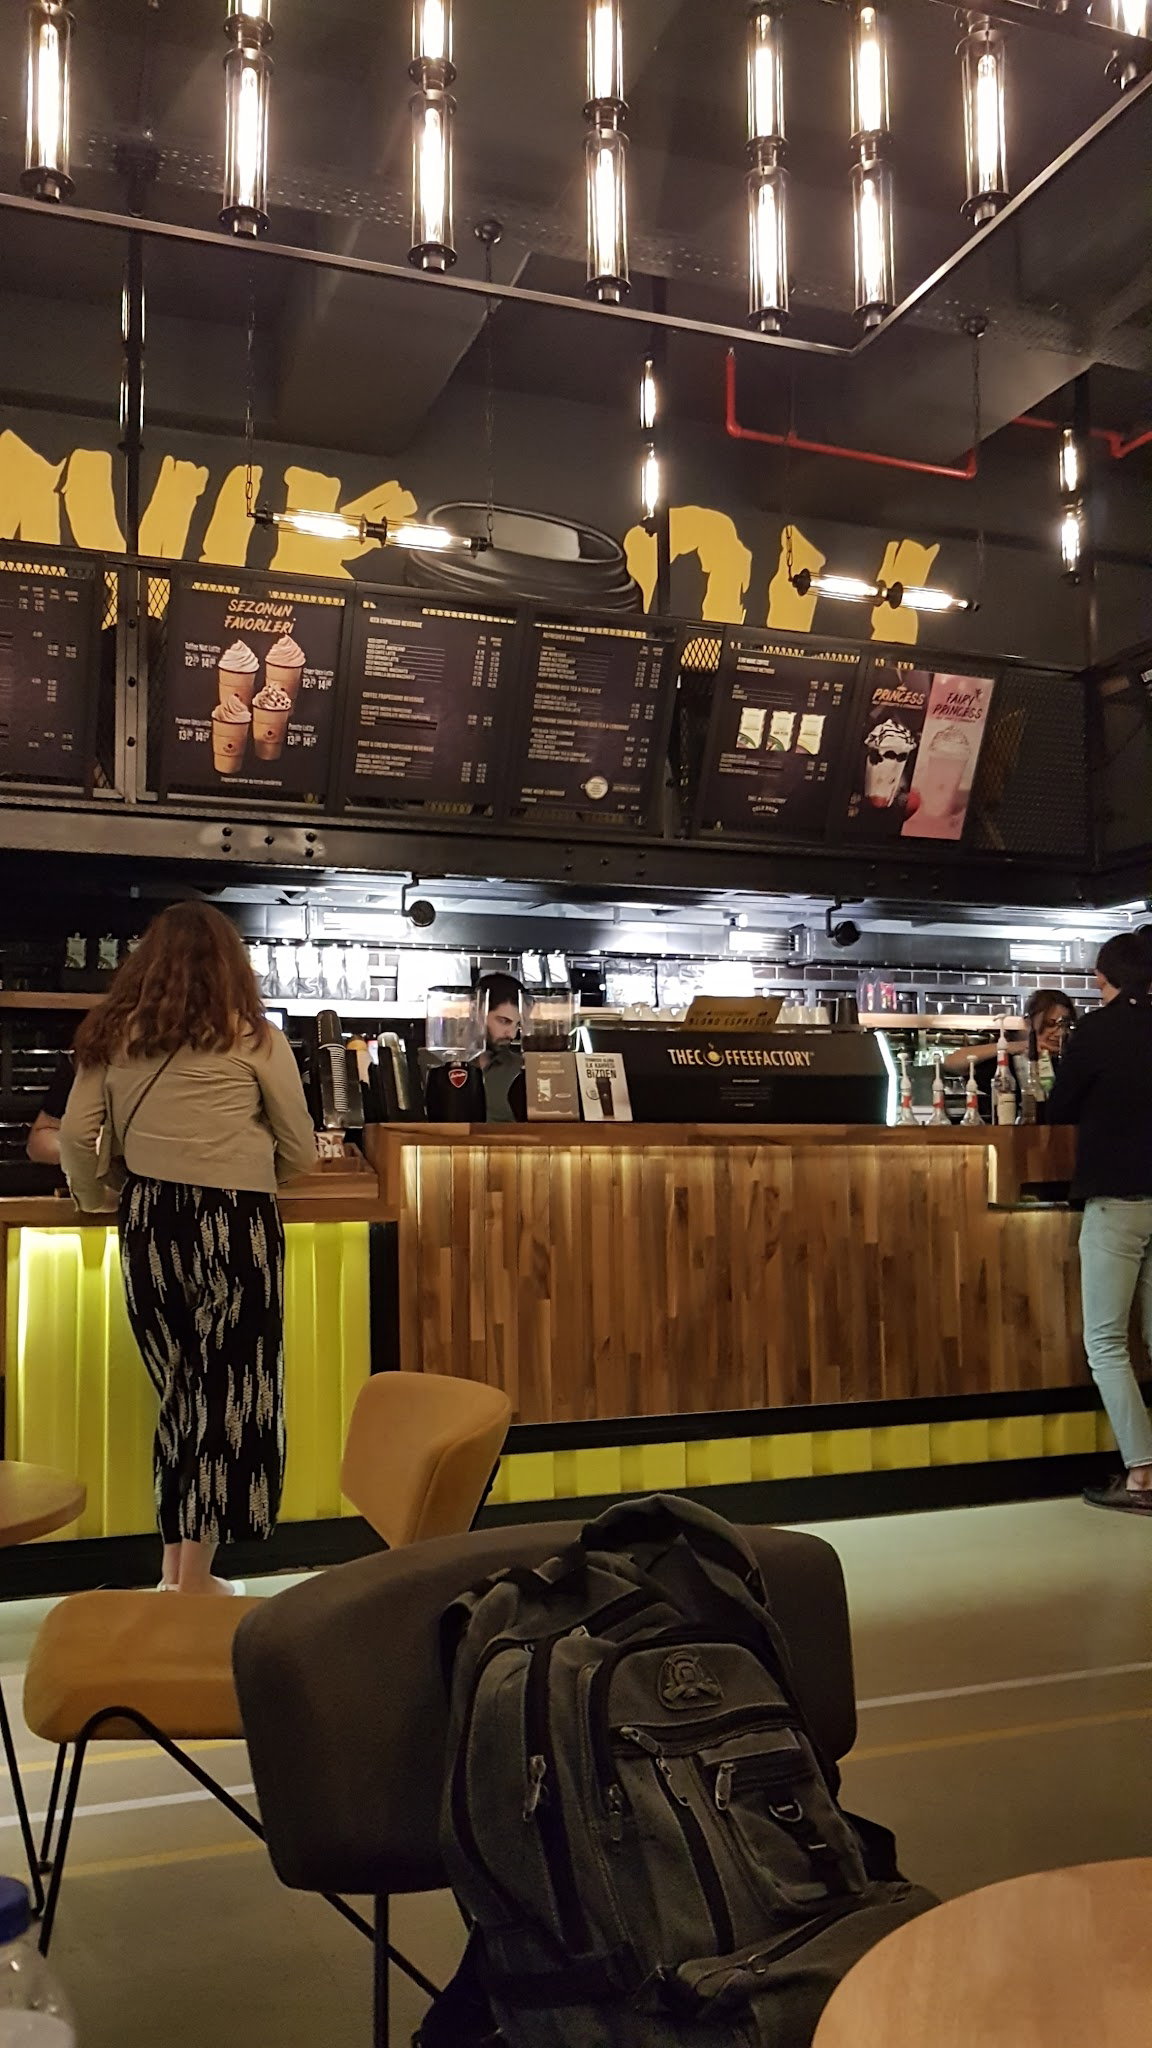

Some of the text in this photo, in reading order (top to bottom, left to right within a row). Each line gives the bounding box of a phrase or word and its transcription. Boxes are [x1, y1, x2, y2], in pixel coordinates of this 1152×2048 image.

[228, 599, 293, 617] SEZONUN
[871, 687, 925, 705] PRINCESS
[946, 692, 975, 705] FAIRY
[933, 704, 983, 719] PRINCESS
[586, 1068, 616, 1078] BİZDEN
